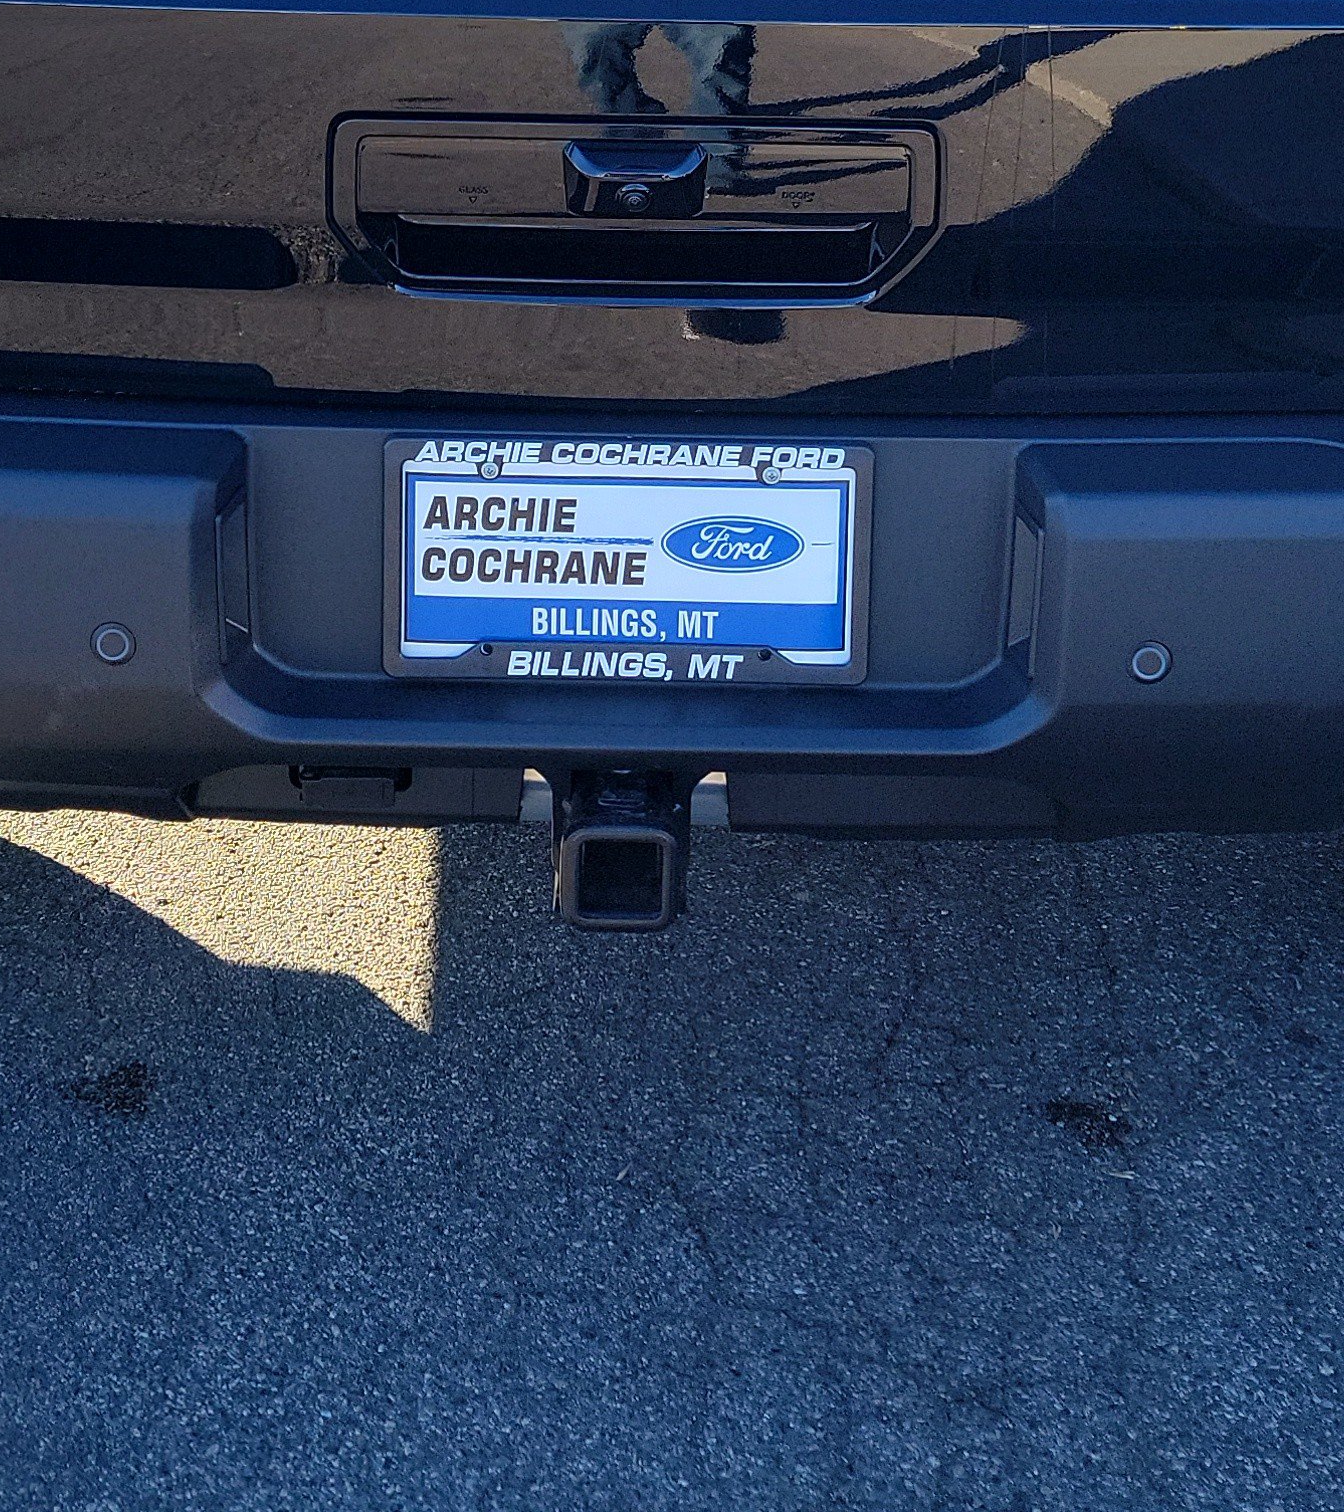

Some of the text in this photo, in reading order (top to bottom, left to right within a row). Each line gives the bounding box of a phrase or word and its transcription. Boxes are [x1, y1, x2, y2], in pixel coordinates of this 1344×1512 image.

[415, 440, 846, 470] ARCHIE COCHRANE FORD
[423, 495, 578, 533] ARCHIE
[691, 524, 775, 561] Ford
[421, 547, 648, 586] COCHRANE
[532, 607, 720, 642] BILLINGS, MT
[506, 650, 745, 682] BILLINGS, MT
